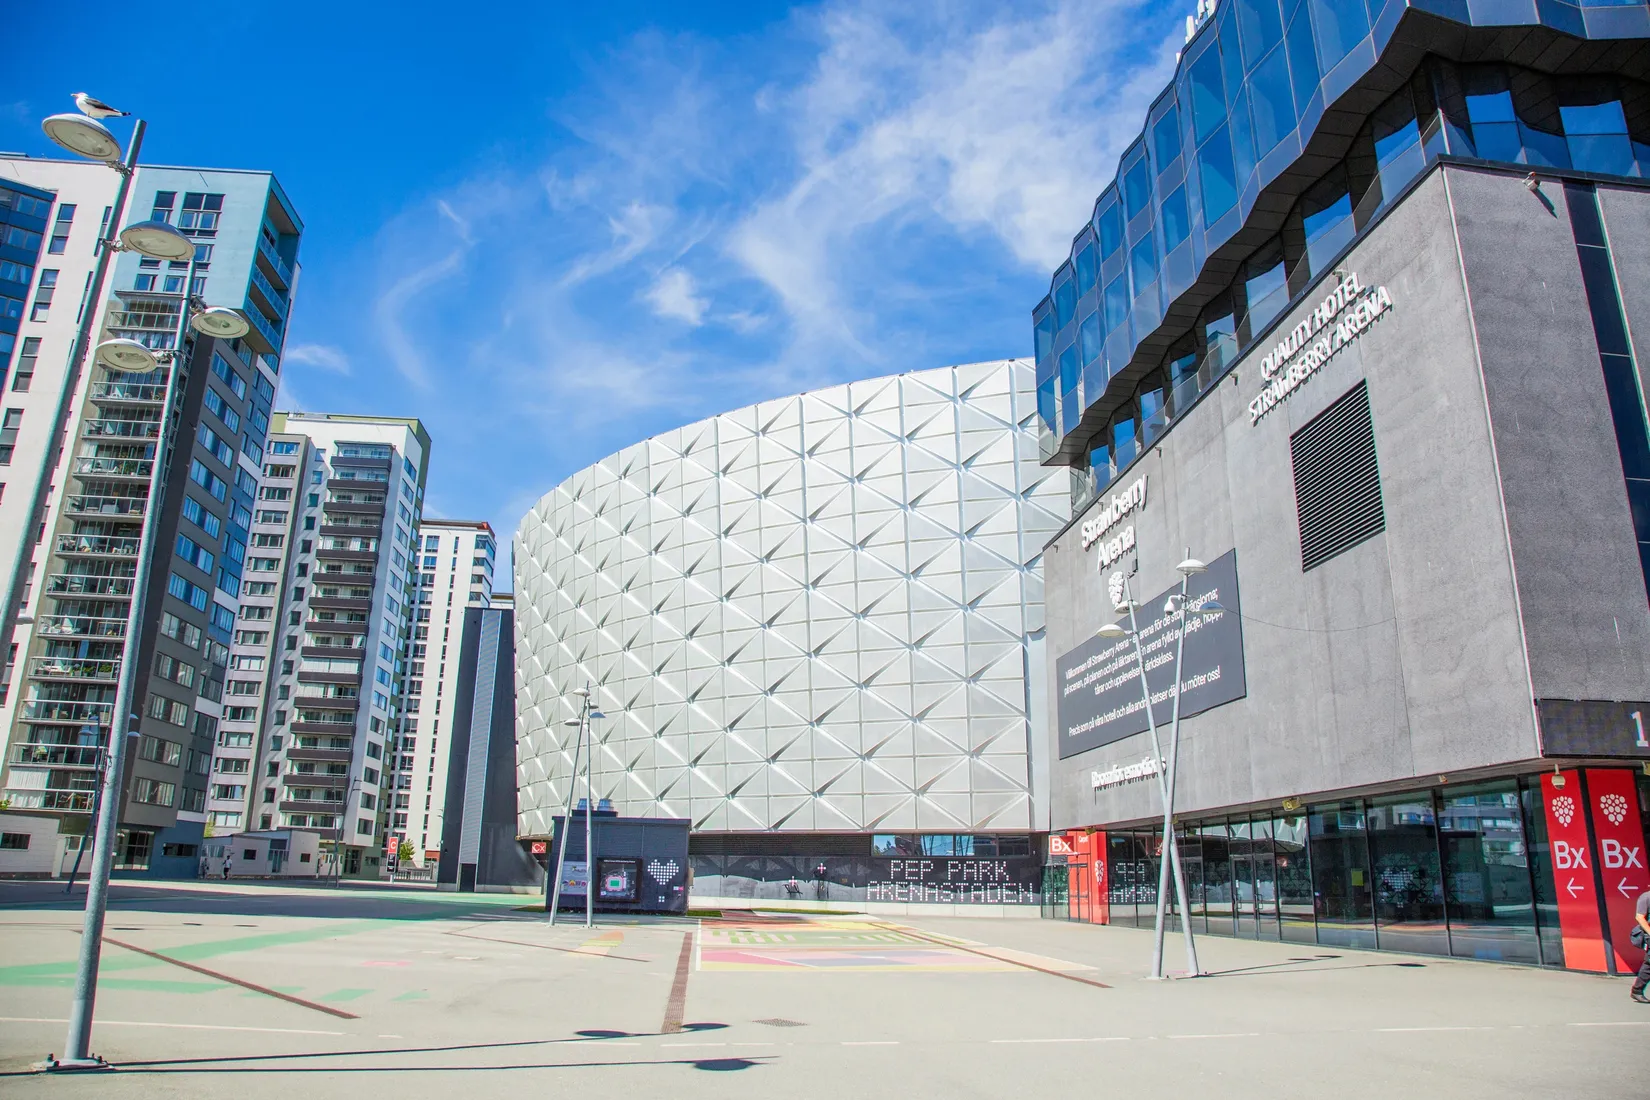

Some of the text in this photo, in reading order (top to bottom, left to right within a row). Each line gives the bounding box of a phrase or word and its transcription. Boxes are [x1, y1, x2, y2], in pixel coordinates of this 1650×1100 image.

[1260, 271, 1366, 382] QUALITY HOTEL
[1248, 285, 1392, 423] STRAWBERRY ARENA
[1081, 473, 1147, 549] Strawberry
[1096, 525, 1136, 572] Arena
[1092, 646, 1115, 666] Strawberry
[1115, 638, 1129, 654] Arena
[1139, 624, 1155, 640] arena
[1154, 618, 1163, 631] för
[1162, 612, 1171, 627] de
[1146, 638, 1161, 654] arena
[1161, 628, 1174, 648] fylld
[1144, 651, 1174, 672] ärldsklass.
[1103, 708, 1117, 724] hotell
[1116, 704, 1126, 719] och
[1126, 701, 1135, 715] alla
[1134, 696, 1147, 712] andr
[1168, 684, 1177, 698] dä
[1187, 673, 1207, 691] möter
[1206, 664, 1221, 683] oss!
[1630, 709, 1650, 747] 1
[390, 841, 397, 850] C
[532, 843, 545, 853] Cx
[1051, 837, 1072, 852] Bx
[1553, 840, 1588, 869] Bx
[1601, 838, 1643, 869] Bx
[890, 859, 1010, 881] PEP PARK
[867, 880, 1034, 903] ARENASTADEN
